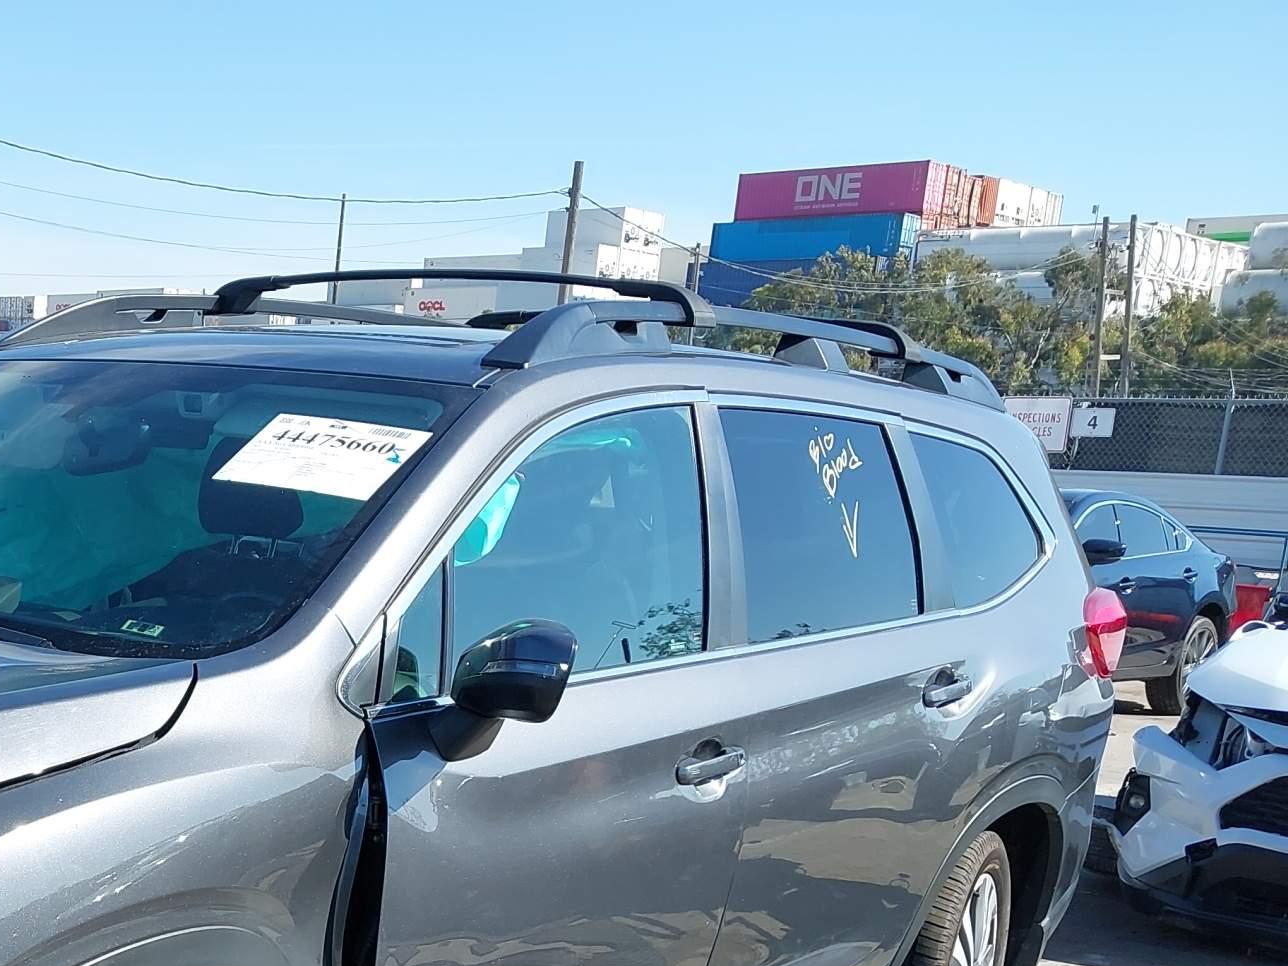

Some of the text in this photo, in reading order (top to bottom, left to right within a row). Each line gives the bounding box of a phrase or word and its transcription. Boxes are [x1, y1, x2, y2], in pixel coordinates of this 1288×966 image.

[795, 172, 862, 202] ONE
[1011, 412, 1062, 423] SPECTIONS
[1087, 415, 1098, 430] 4
[272, 429, 396, 454] 44475660
[822, 438, 863, 498] Blood
